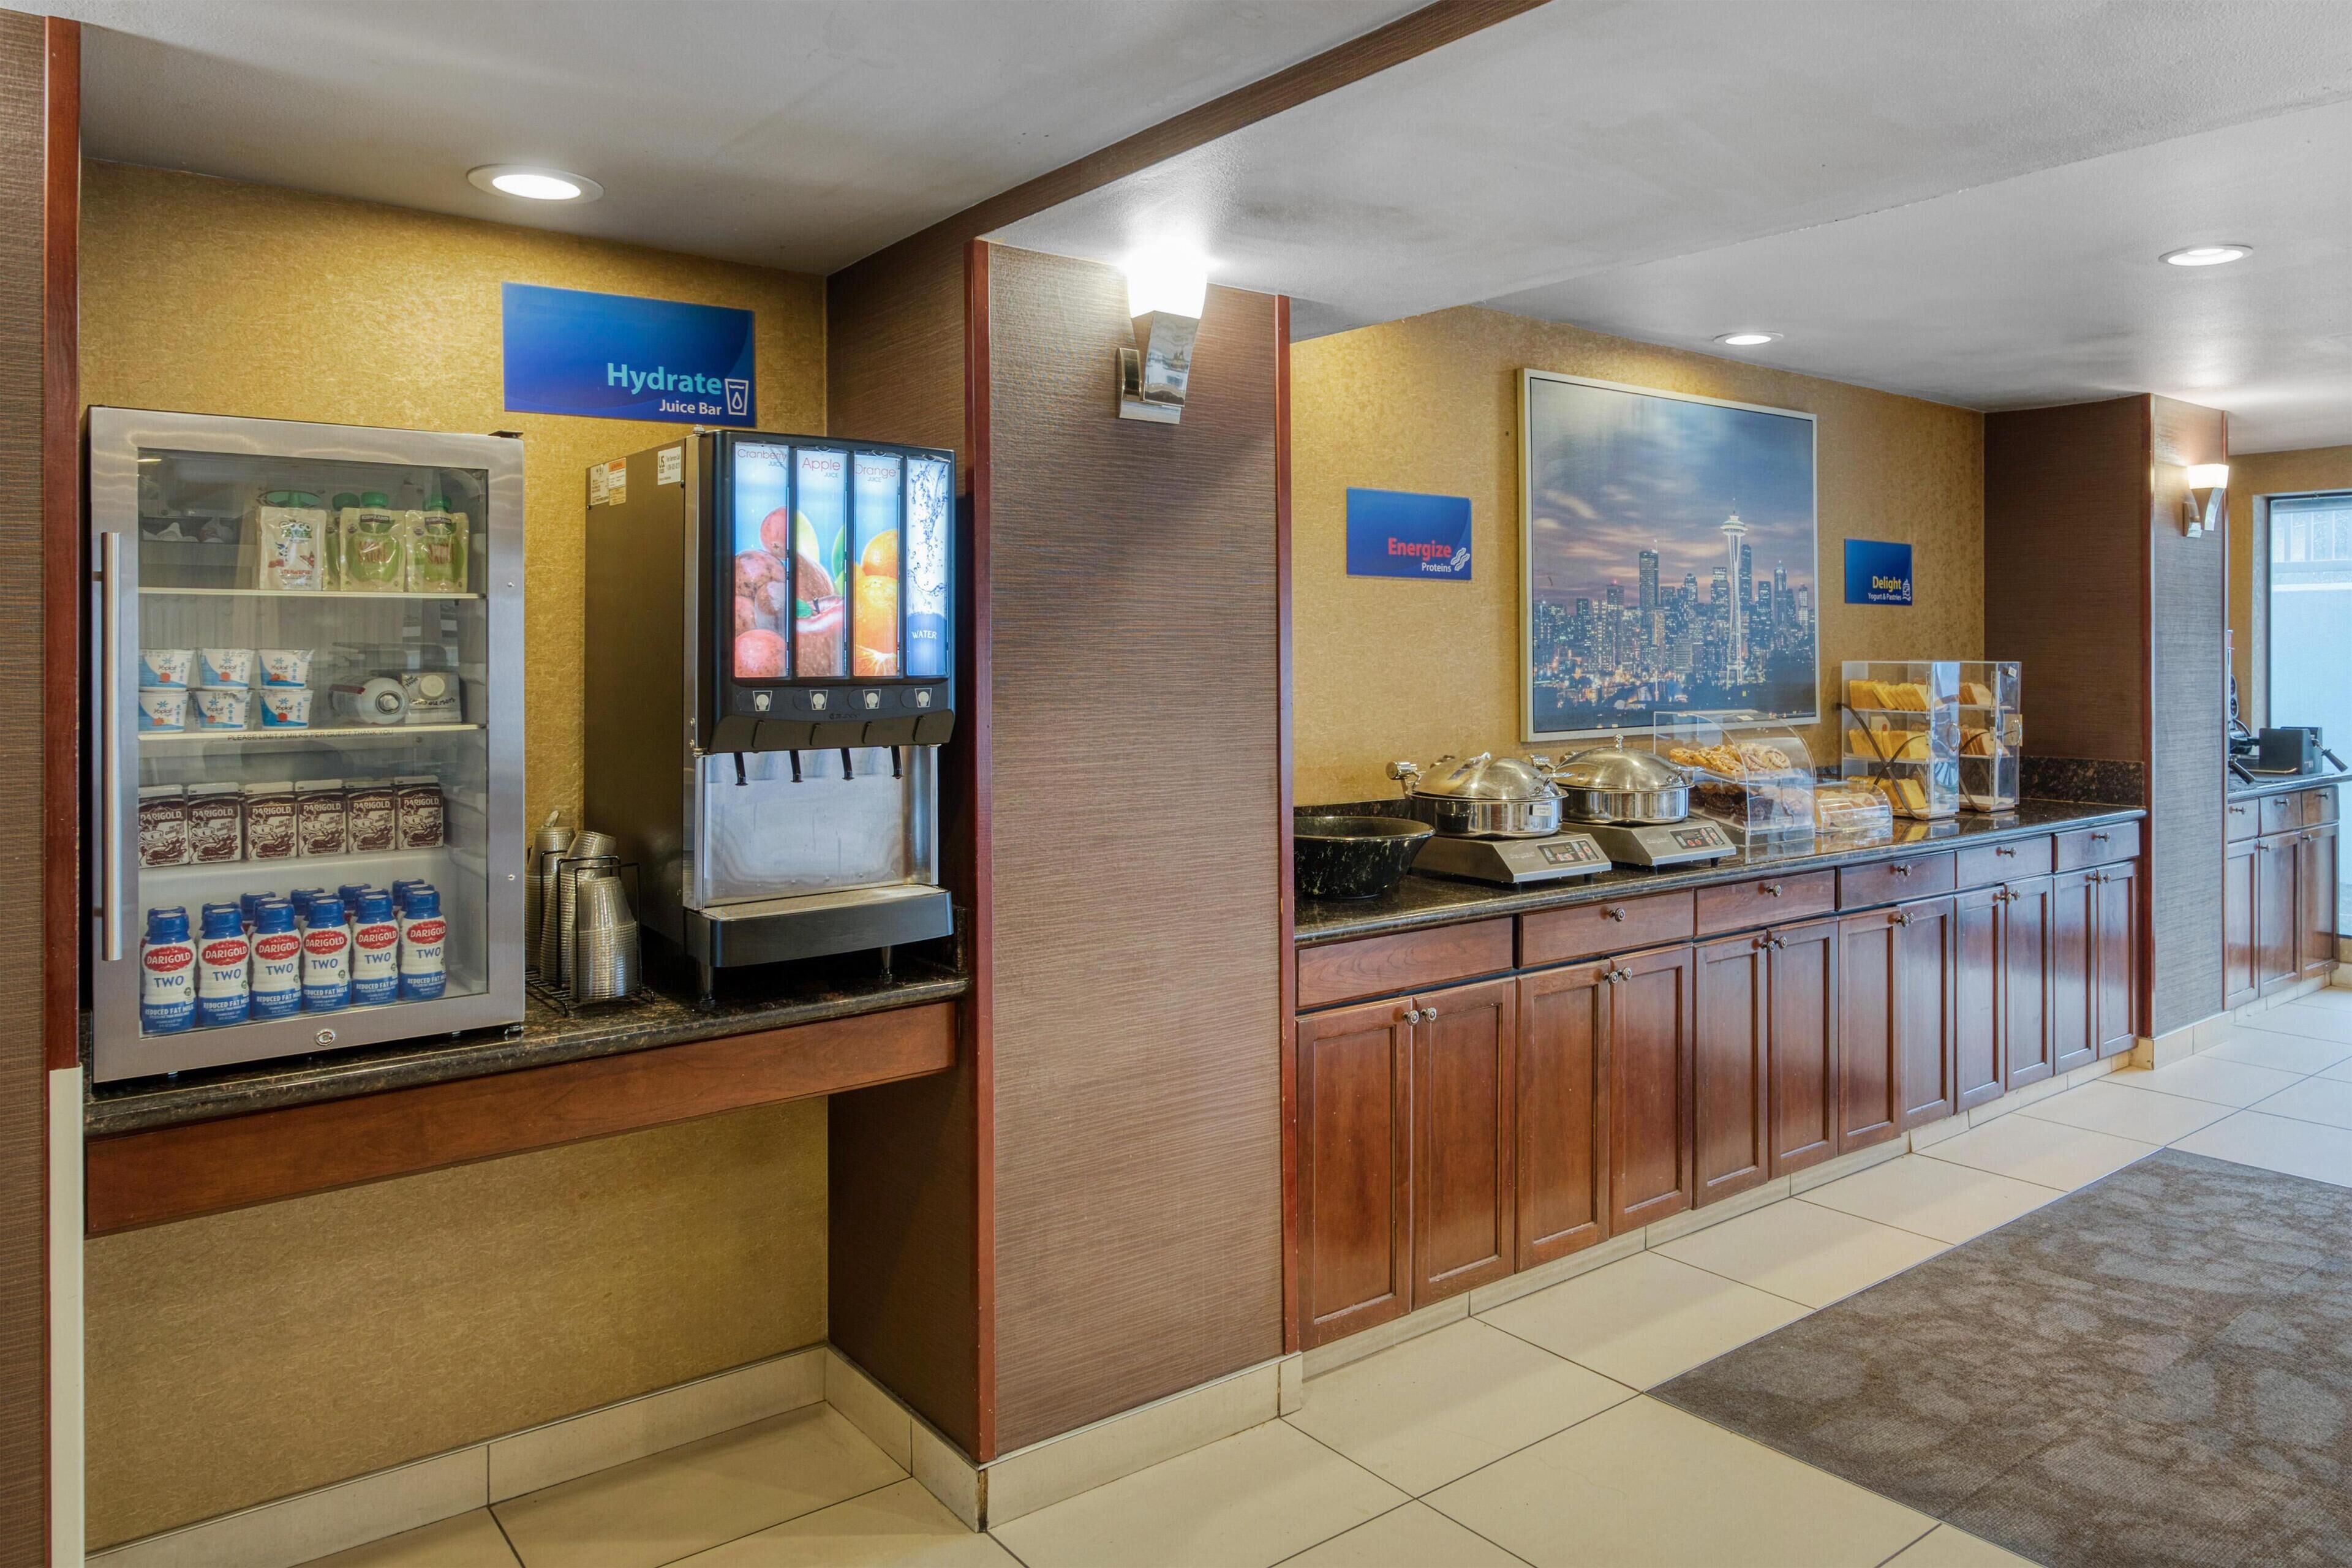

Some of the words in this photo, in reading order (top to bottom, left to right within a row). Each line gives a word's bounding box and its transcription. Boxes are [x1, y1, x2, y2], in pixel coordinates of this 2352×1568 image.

[608, 363, 722, 395] Hydrate
[659, 399, 695, 413] Juice
[699, 402, 722, 415] Bar
[737, 449, 787, 461] Cranberry
[802, 458, 840, 471] Apple
[1388, 537, 1452, 561] Energize
[1422, 562, 1452, 572] Proteins
[1872, 576, 1901, 592] Delight
[911, 630, 937, 639] WATER
[304, 803, 341, 812] DARIGOLD
[404, 797, 439, 806] DARIGOLD
[140, 811, 182, 821] DARIGOLD
[193, 809, 233, 818] DARIGOLD
[252, 806, 292, 815] DARIGOLD
[358, 930, 398, 943] DARIGOLD
[410, 925, 446, 938] DARIGOLD
[258, 941, 299, 953] DARIGOLD
[306, 937, 344, 947] DARIGOLD
[147, 952, 191, 965] DARIGOLD
[205, 946, 247, 959] DARIGOLD
[364, 952, 391, 964] TWO
[417, 947, 442, 959] TWO
[266, 963, 294, 975] TWO
[312, 959, 339, 970] TWO
[213, 969, 242, 981] TWO
[154, 976, 184, 988] TWO
